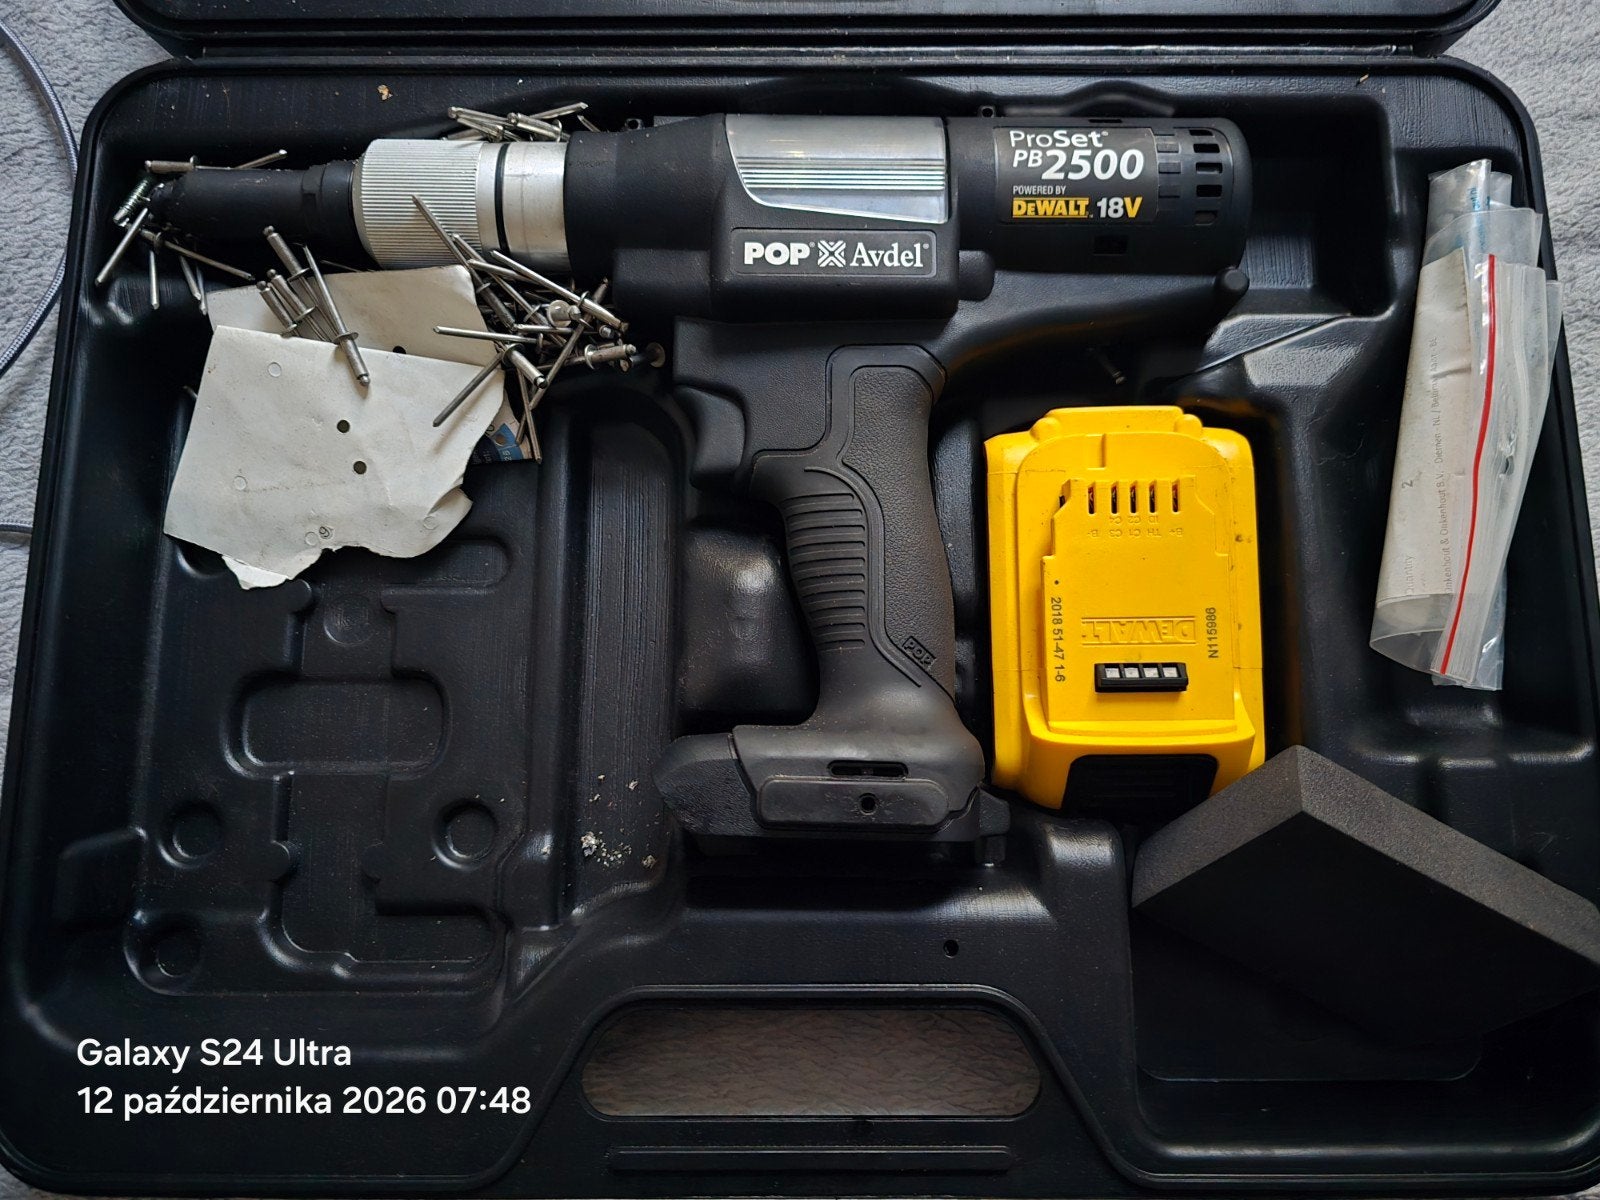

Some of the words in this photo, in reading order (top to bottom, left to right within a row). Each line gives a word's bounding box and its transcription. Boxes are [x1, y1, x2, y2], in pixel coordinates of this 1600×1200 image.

[1009, 130, 1104, 148] ProSet
[1013, 185, 1054, 195] POWERED
[1055, 185, 1067, 195] BY
[1097, 197, 1143, 218] 18V
[850, 242, 924, 267] Avdel
[1401, 479, 1413, 489] 2
[1051, 596, 1063, 625] 2018
[1205, 607, 1218, 658] N115986
[1053, 628, 1065, 660] 51-47
[1054, 664, 1066, 682] 1-6
